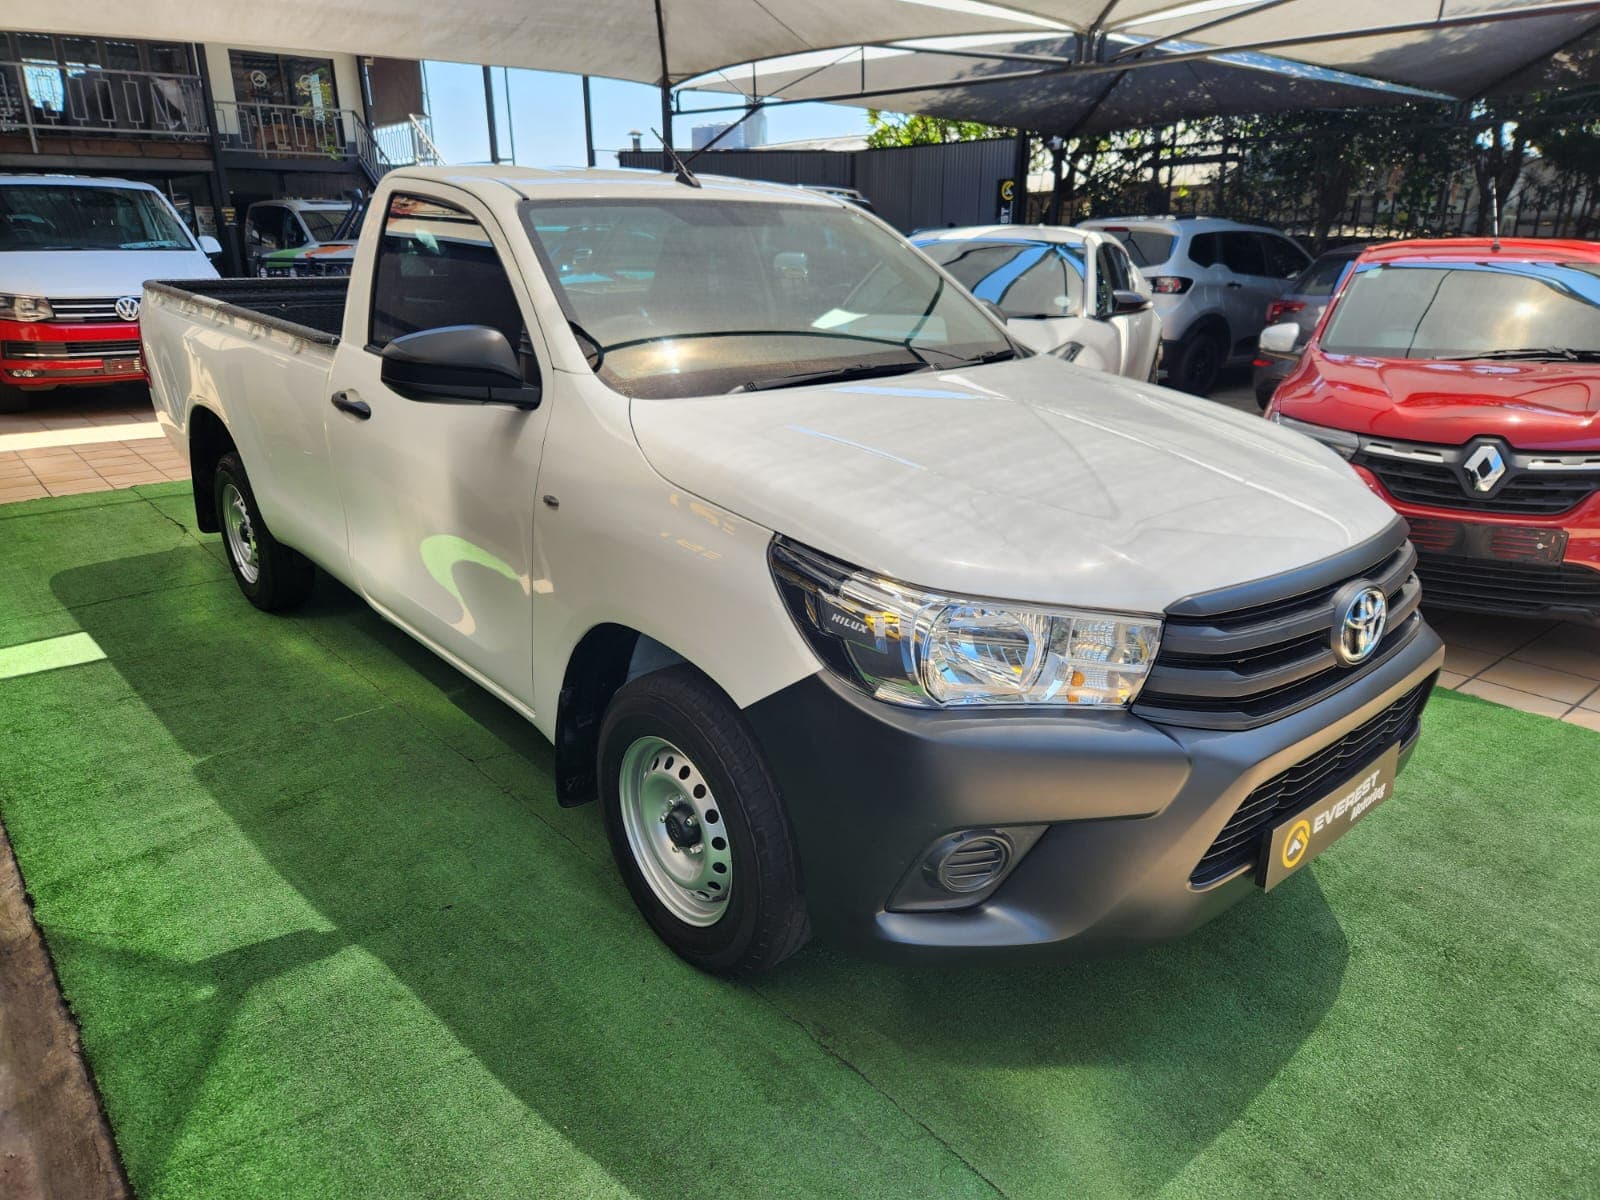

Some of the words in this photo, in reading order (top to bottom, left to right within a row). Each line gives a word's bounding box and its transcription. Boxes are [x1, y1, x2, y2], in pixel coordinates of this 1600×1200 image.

[115, 296, 139, 321] VW
[831, 613, 868, 634] HILUX
[1313, 769, 1380, 834] EVEREST
